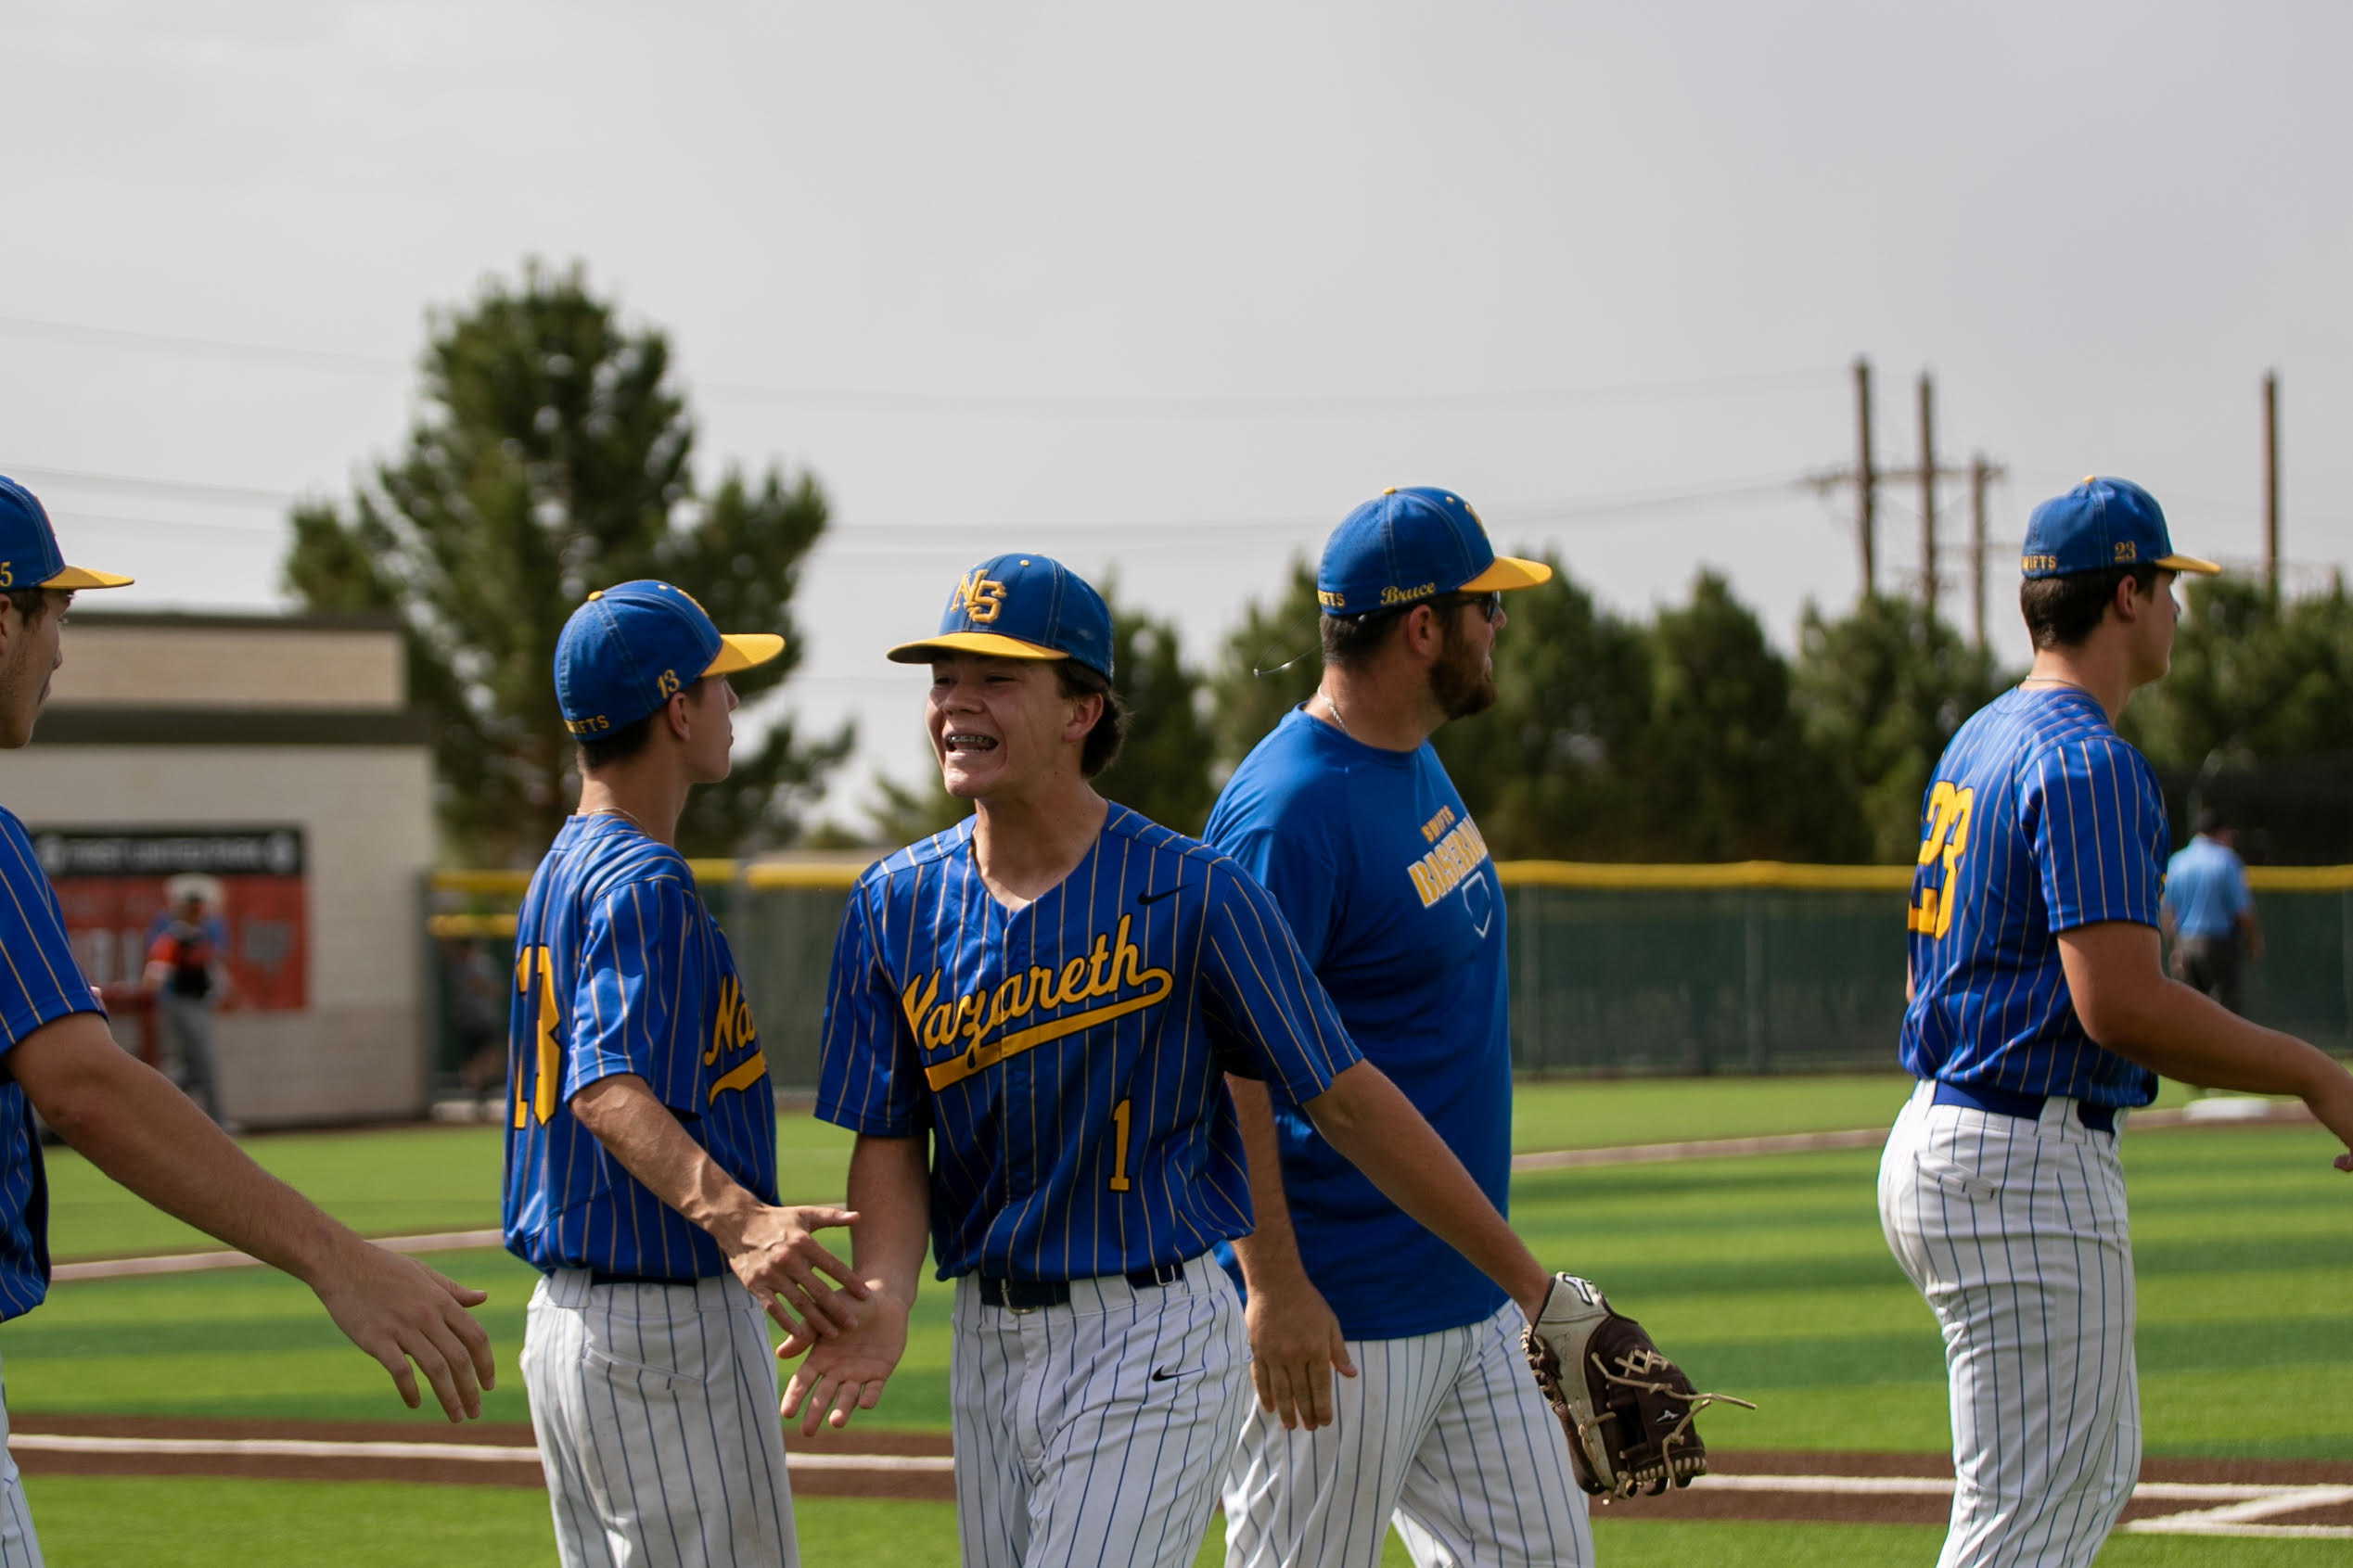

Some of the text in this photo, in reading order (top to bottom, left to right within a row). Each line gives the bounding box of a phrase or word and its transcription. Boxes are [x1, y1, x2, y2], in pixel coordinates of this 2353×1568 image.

[948, 568, 1007, 623] NS
[1379, 581, 1436, 606] Bruce
[657, 669, 681, 699] 13
[1908, 781, 1974, 940] 23
[1109, 1098, 1132, 1193] 1
